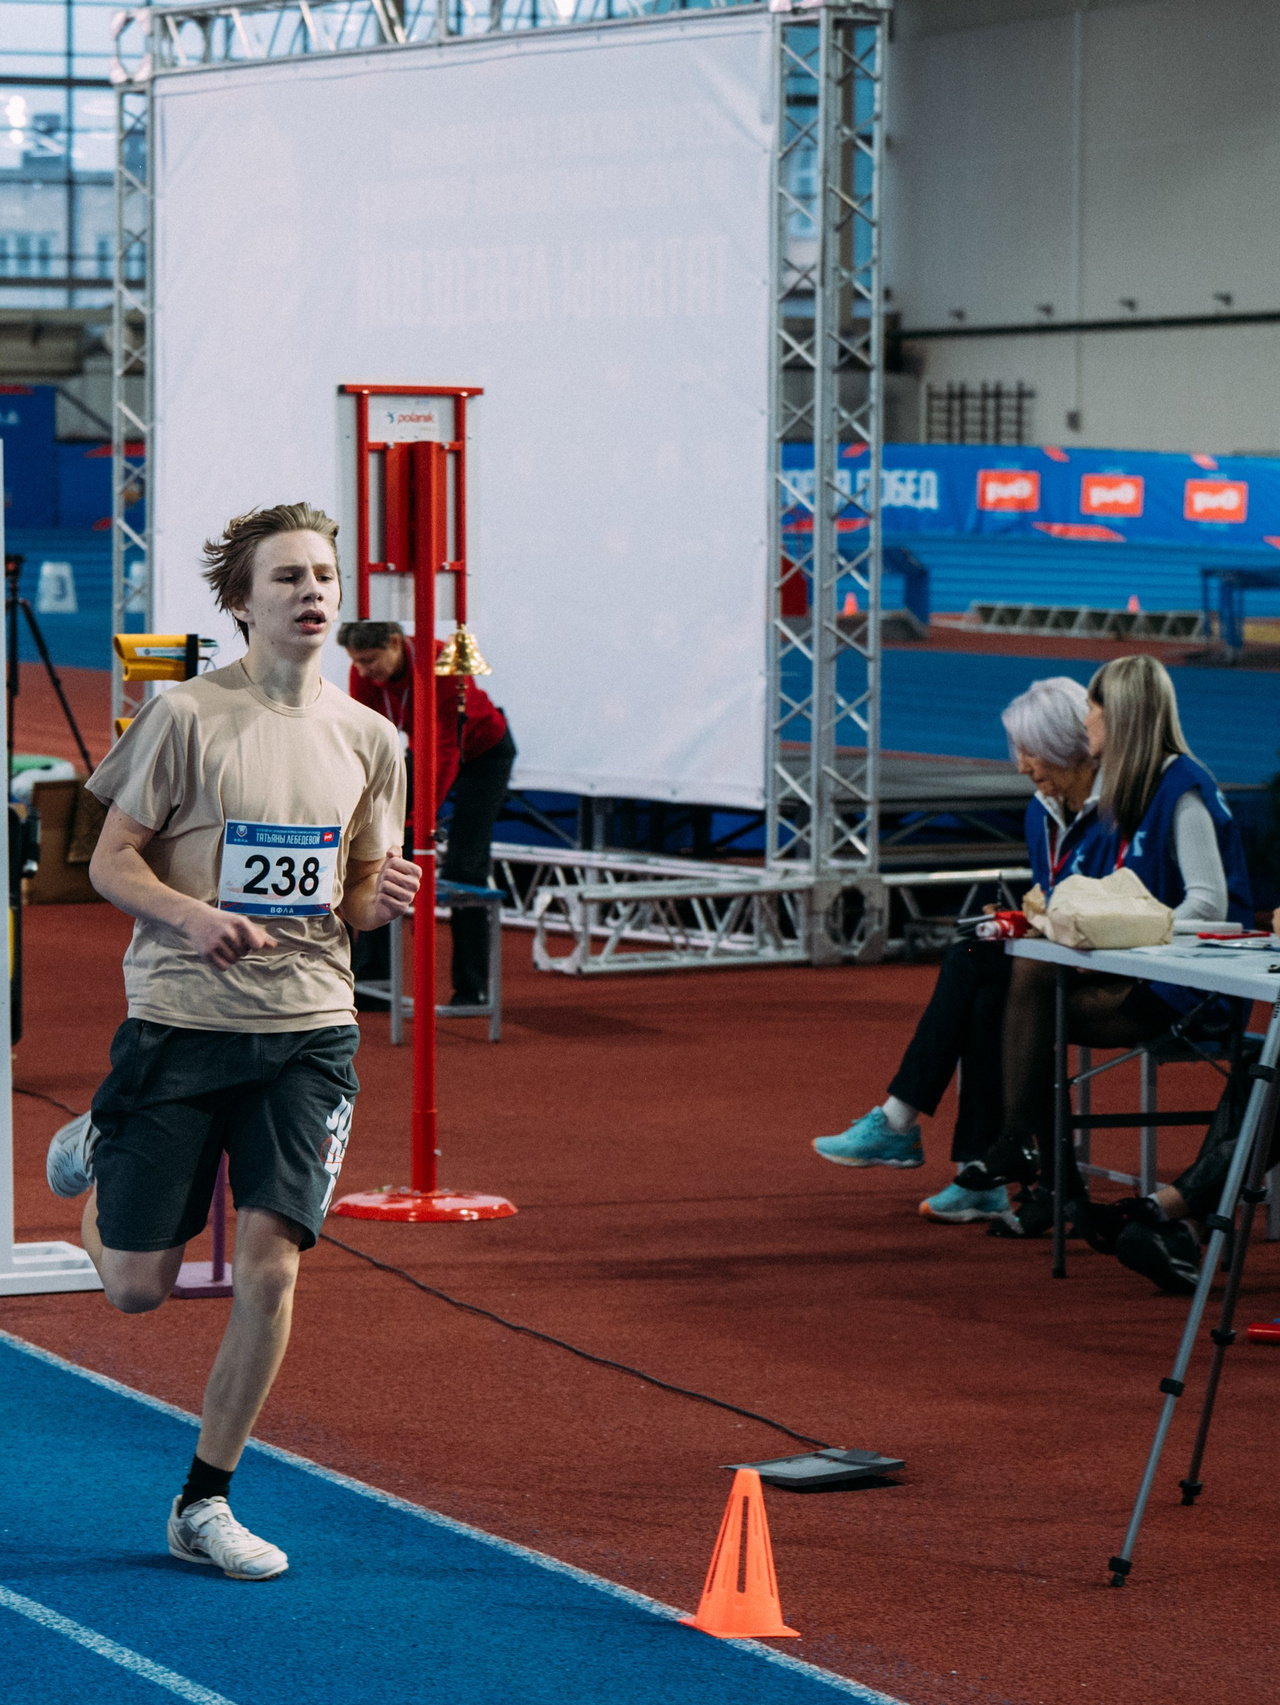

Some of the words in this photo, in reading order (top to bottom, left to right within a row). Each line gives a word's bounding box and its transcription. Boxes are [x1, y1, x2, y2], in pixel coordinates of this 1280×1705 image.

[256, 832, 286, 845] ТАТЬЯНЫ
[286, 833, 320, 846] ЛЕБЕДЕВОЙ
[243, 854, 320, 897] 238
[270, 906, 294, 914] ВФЛА
